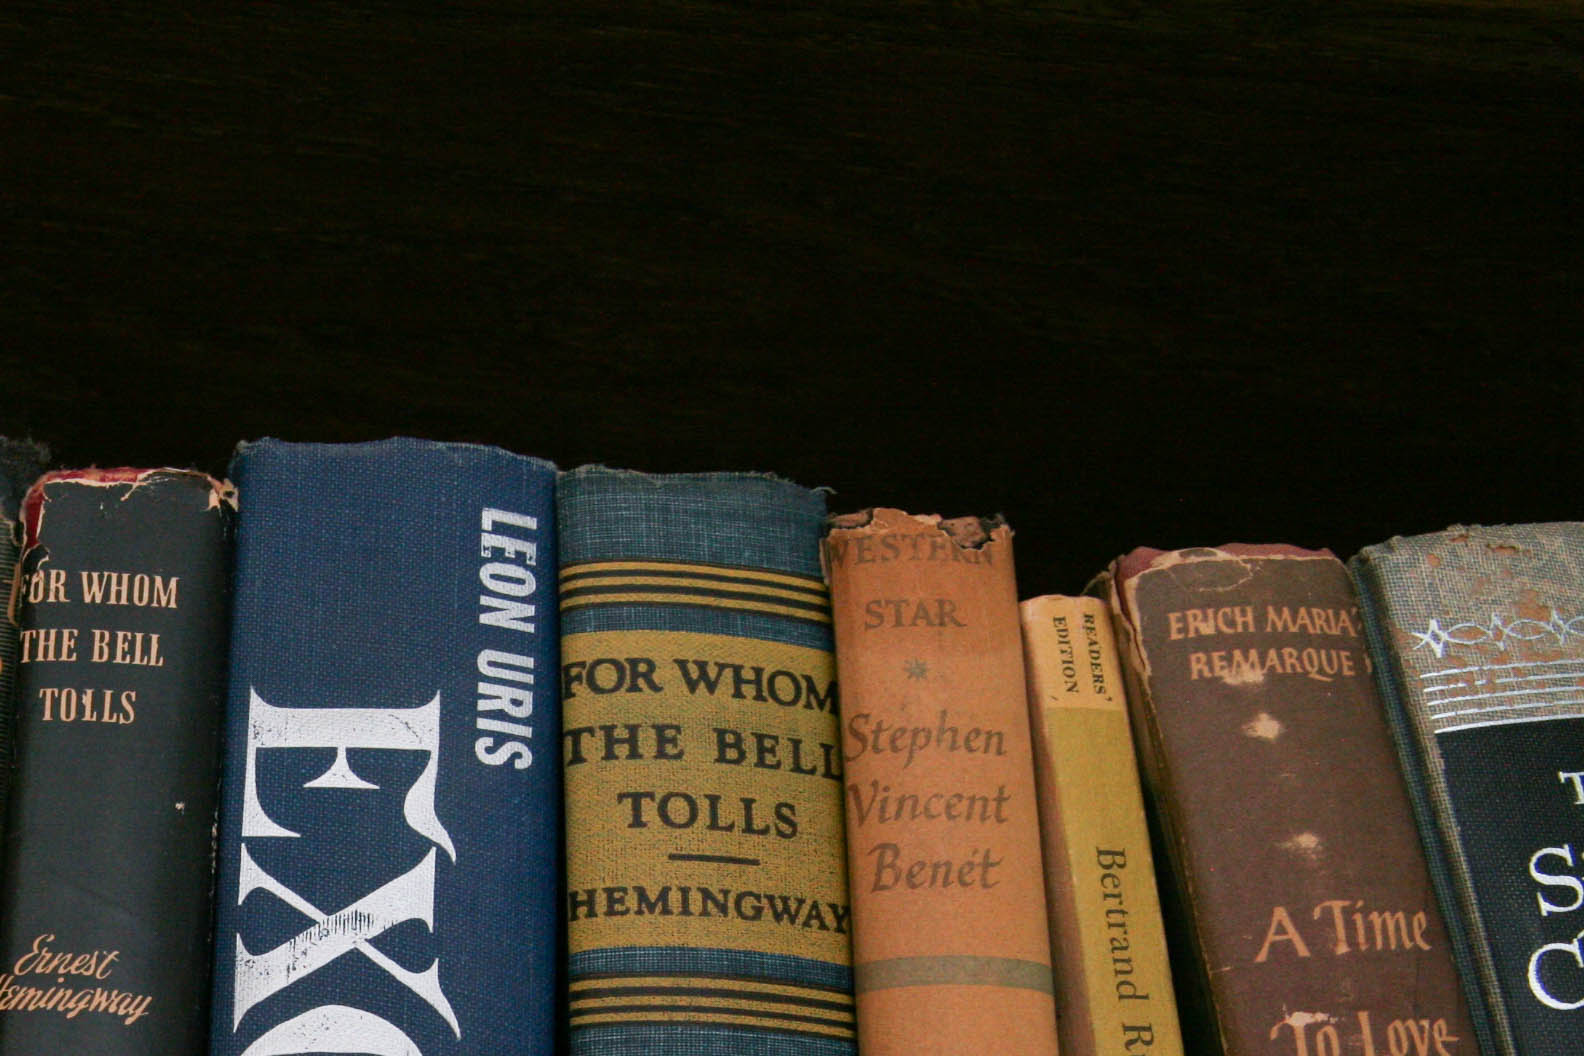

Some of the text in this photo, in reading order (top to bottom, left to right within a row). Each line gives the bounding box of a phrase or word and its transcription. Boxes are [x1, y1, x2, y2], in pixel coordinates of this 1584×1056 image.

[80, 571, 180, 609] WHOM
[474, 507, 537, 770] LEON URIS
[864, 600, 967, 631] STAR
[1168, 605, 1358, 640] ERICH MARIA
[20, 629, 164, 667] THE BELL
[1052, 615, 1079, 695] EDITION
[1190, 648, 1355, 683] REMARQUE
[39, 687, 137, 725] TOLLS
[561, 657, 840, 716] FOR WHOM
[564, 723, 845, 781] THE BELL
[845, 708, 1008, 769] Stephen
[617, 791, 799, 839] TOLLS
[847, 779, 1012, 826] Vincent
[568, 885, 852, 935] HEMINGWAY
[1095, 846, 1150, 1001] Bertrand
[1254, 899, 1432, 963] A Time
[14, 934, 120, 979] Ernest
